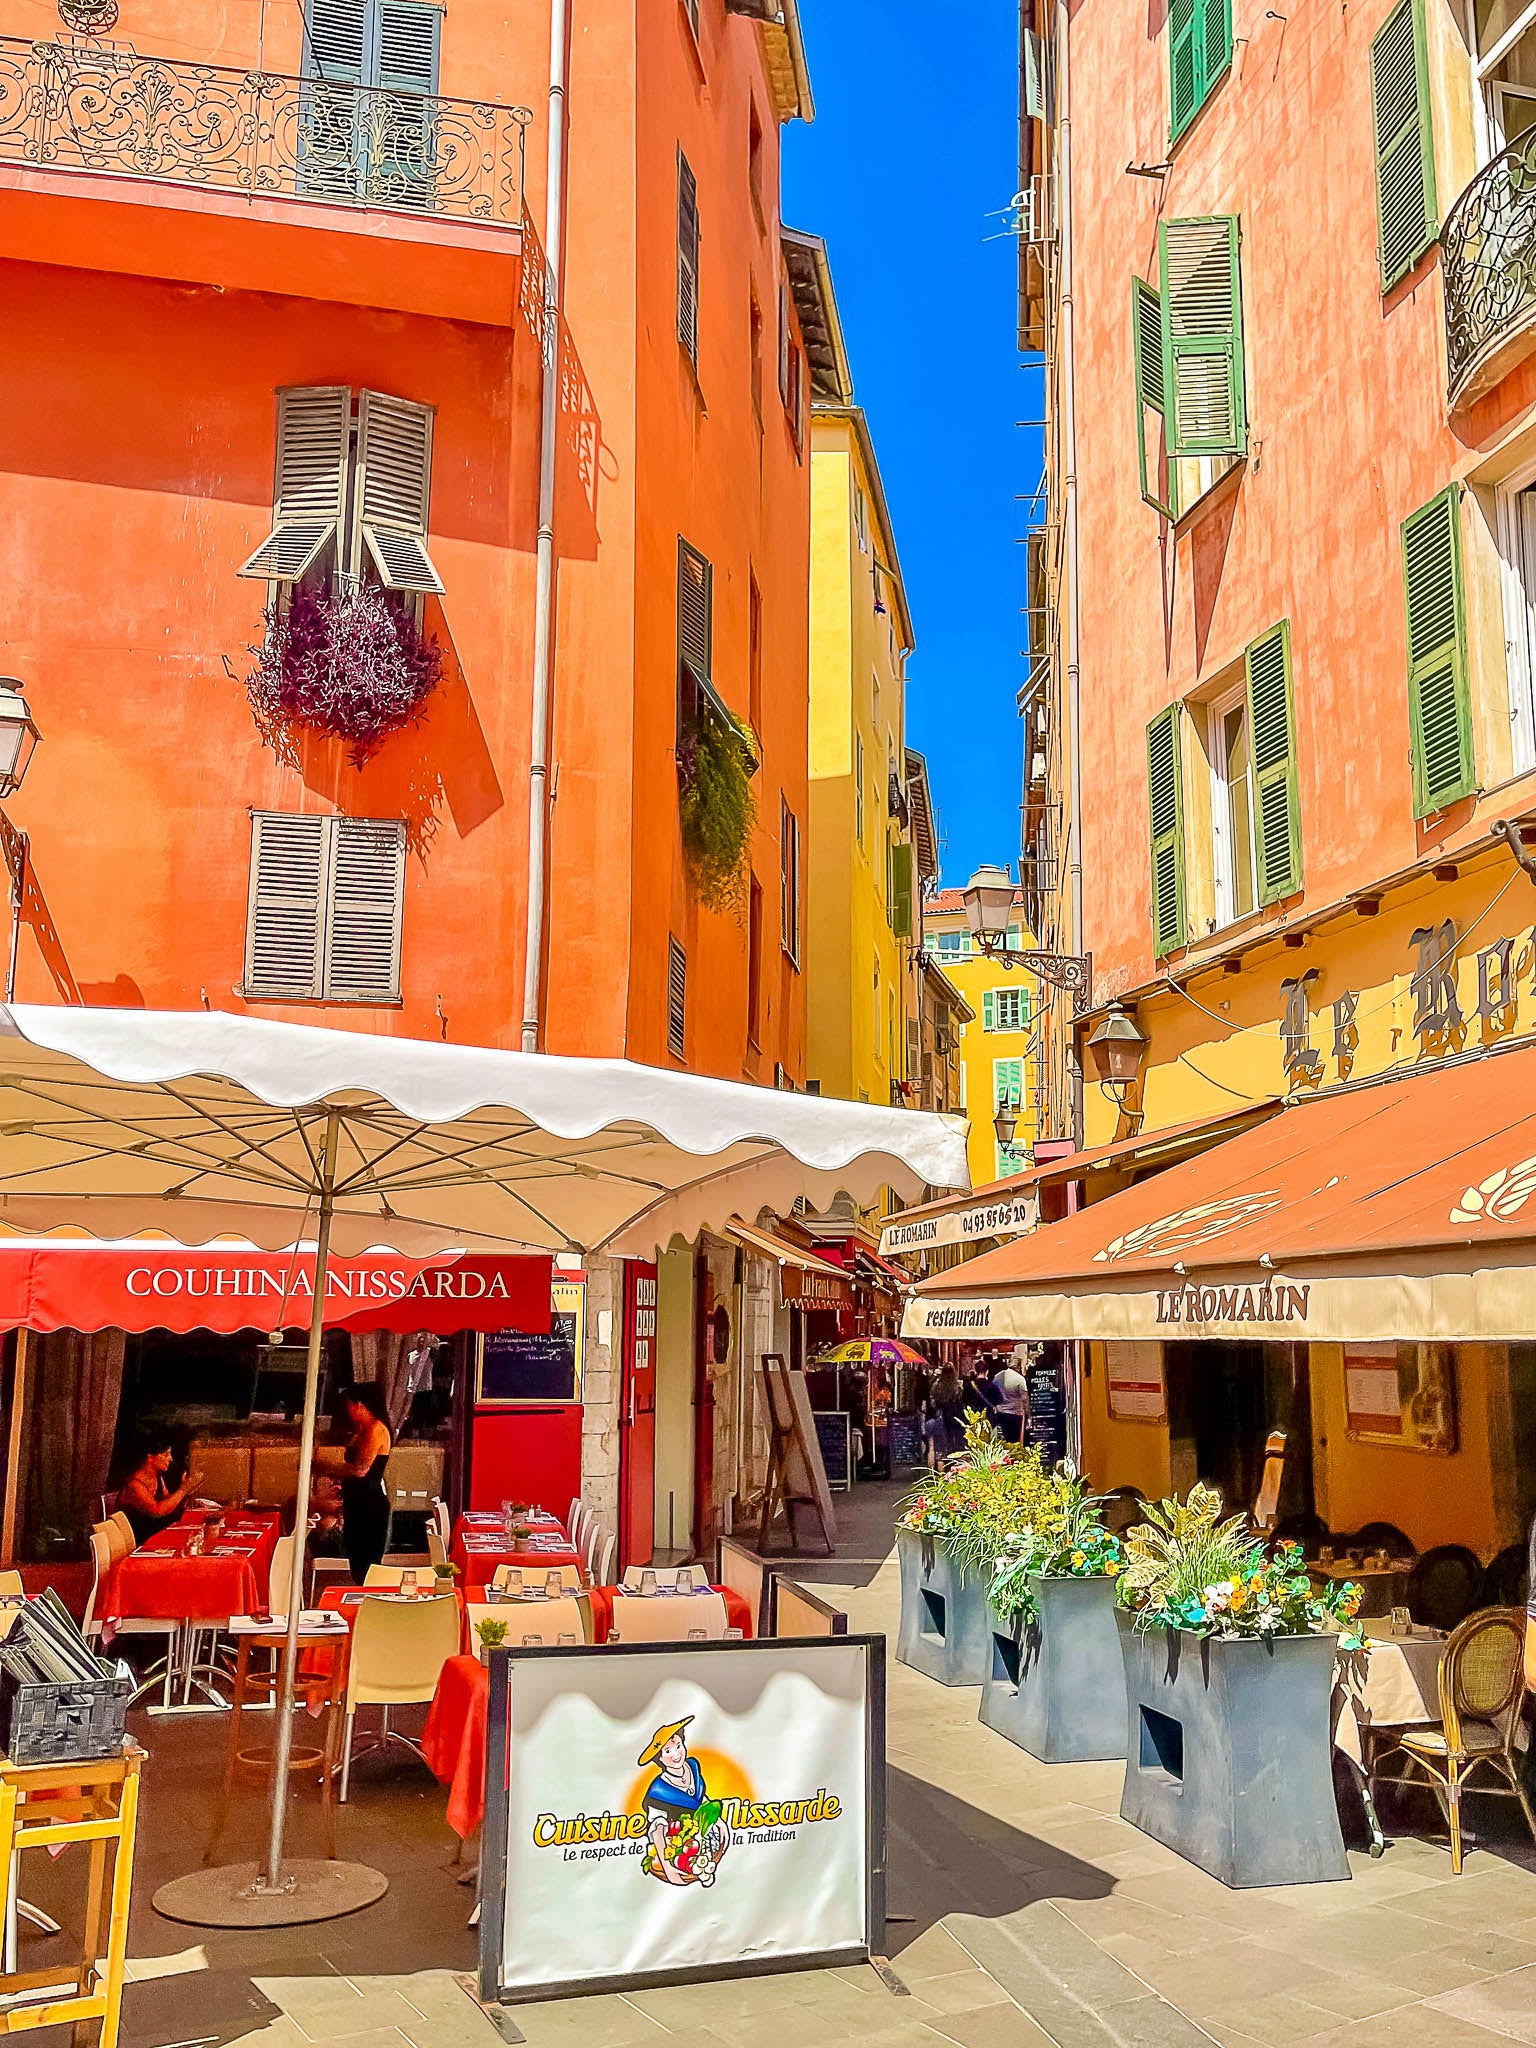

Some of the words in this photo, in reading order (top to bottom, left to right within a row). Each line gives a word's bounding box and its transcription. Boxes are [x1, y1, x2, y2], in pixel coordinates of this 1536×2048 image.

[1408, 917, 1536, 1043] Ro
[889, 1229, 900, 1246] LE
[900, 1221, 938, 1244] ROMARIN
[963, 1217, 973, 1234] 04
[975, 1213, 984, 1233] 93
[986, 1209, 997, 1229] 85
[1013, 1204, 1026, 1223] 20
[125, 1268, 315, 1298] COUHINA
[324, 1269, 511, 1299] NISSARDA
[925, 1304, 991, 1328] restaurant
[1156, 1292, 1182, 1323] LE
[1184, 1285, 1311, 1323] ROMARIN
[533, 1810, 648, 1847] Cuisine
[721, 1788, 843, 1830] Nissarde
[580, 1843, 627, 1862] respect
[628, 1841, 644, 1855] de
[732, 1832, 744, 1845] la
[747, 1829, 796, 1845] Tradition
